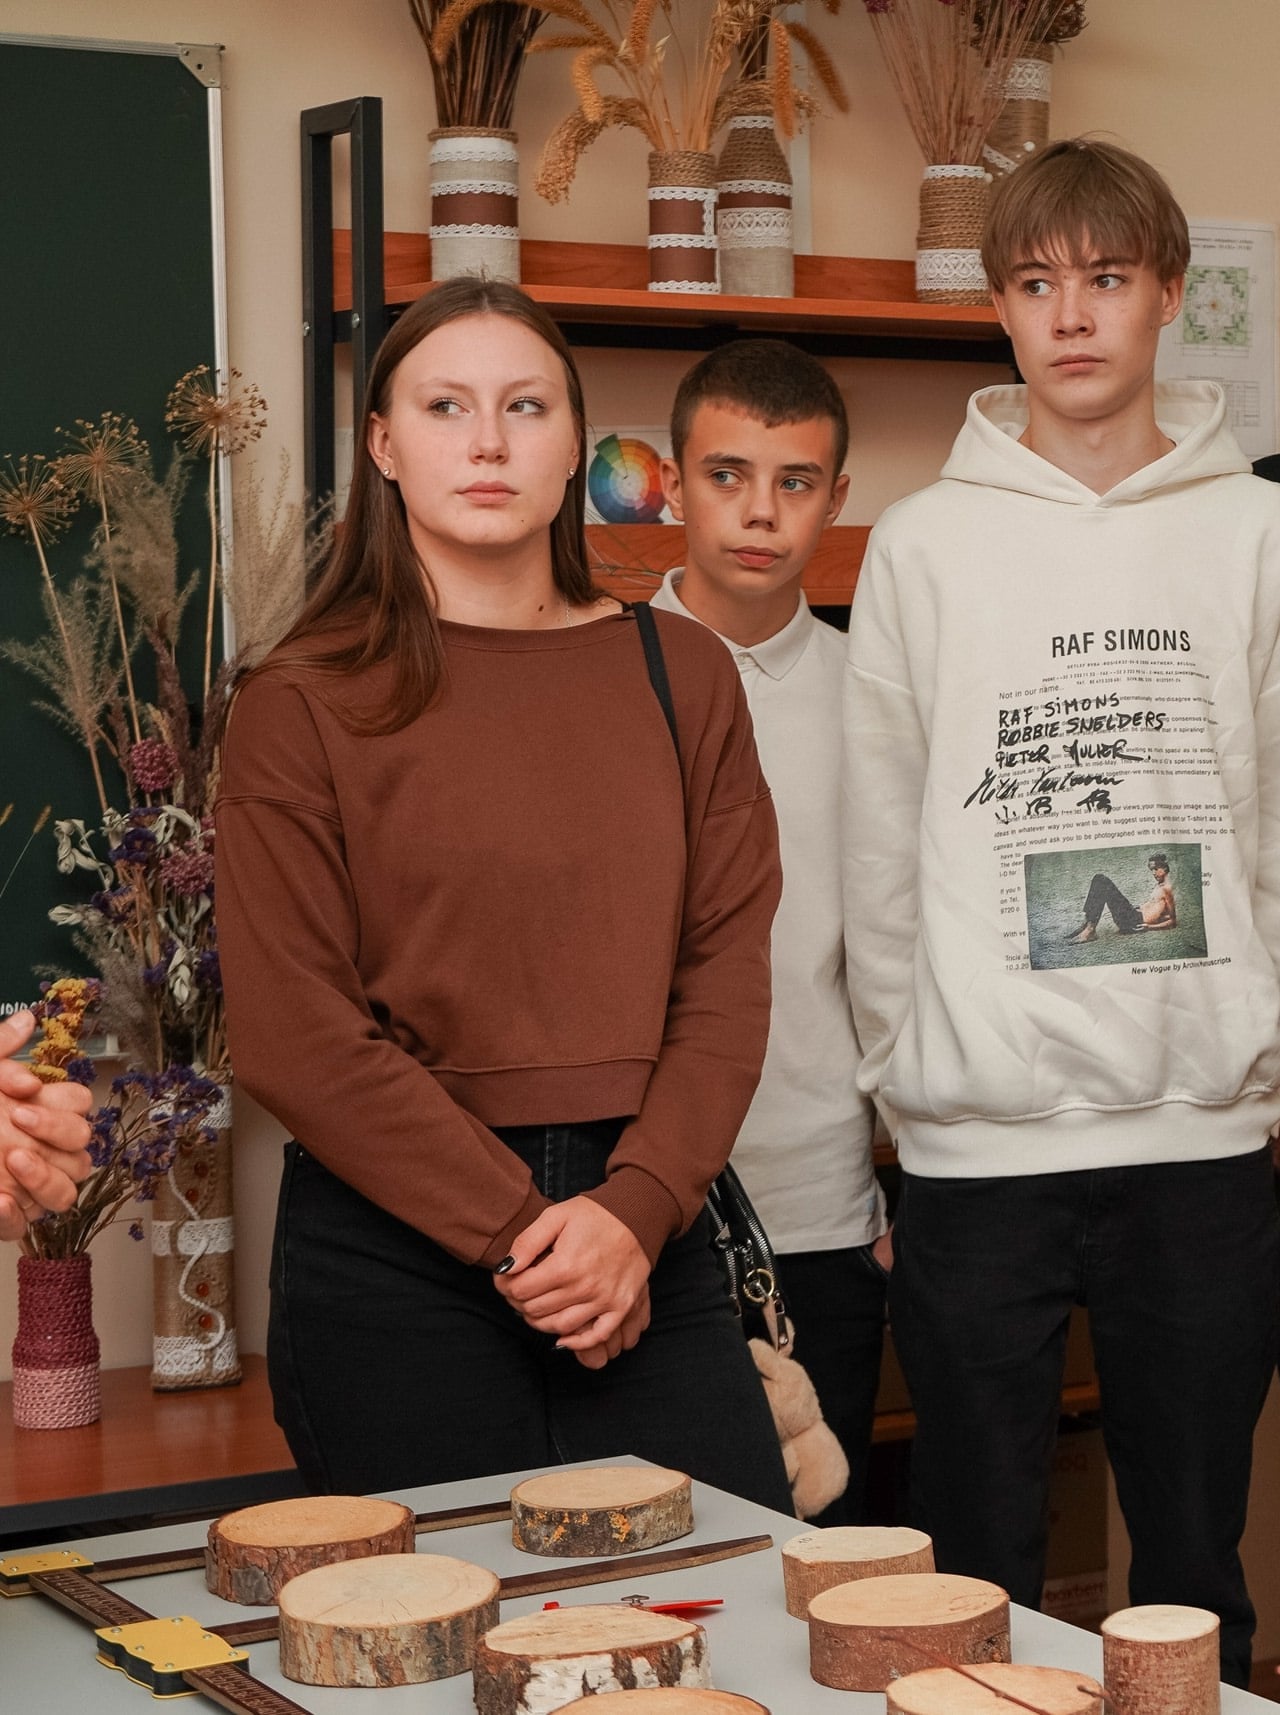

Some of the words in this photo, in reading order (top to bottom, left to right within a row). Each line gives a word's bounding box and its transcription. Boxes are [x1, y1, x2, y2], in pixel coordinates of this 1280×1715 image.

[1052, 631, 1095, 658] RAF
[1104, 629, 1192, 653] SIMONS
[999, 692, 1013, 700] Not
[1025, 688, 1037, 696] our
[999, 706, 1033, 728] RAF
[994, 830, 1009, 838] ideas
[1018, 825, 1045, 834] whatever
[1062, 822, 1074, 830] you
[1114, 816, 1138, 825] suggest
[1139, 816, 1155, 824] using
[1187, 814, 1208, 822] T-shirt
[992, 842, 1013, 851] canvas
[1016, 840, 1027, 848] and
[1029, 838, 1048, 846] would
[1062, 835, 1074, 843] you
[1094, 829, 1135, 841] photographed
[1205, 828, 1217, 836] you
[1005, 887, 1016, 895] you
[1003, 930, 1018, 938] With
[1131, 966, 1147, 975] New
[1149, 964, 1171, 974] Vogue
[1173, 963, 1181, 972] by
